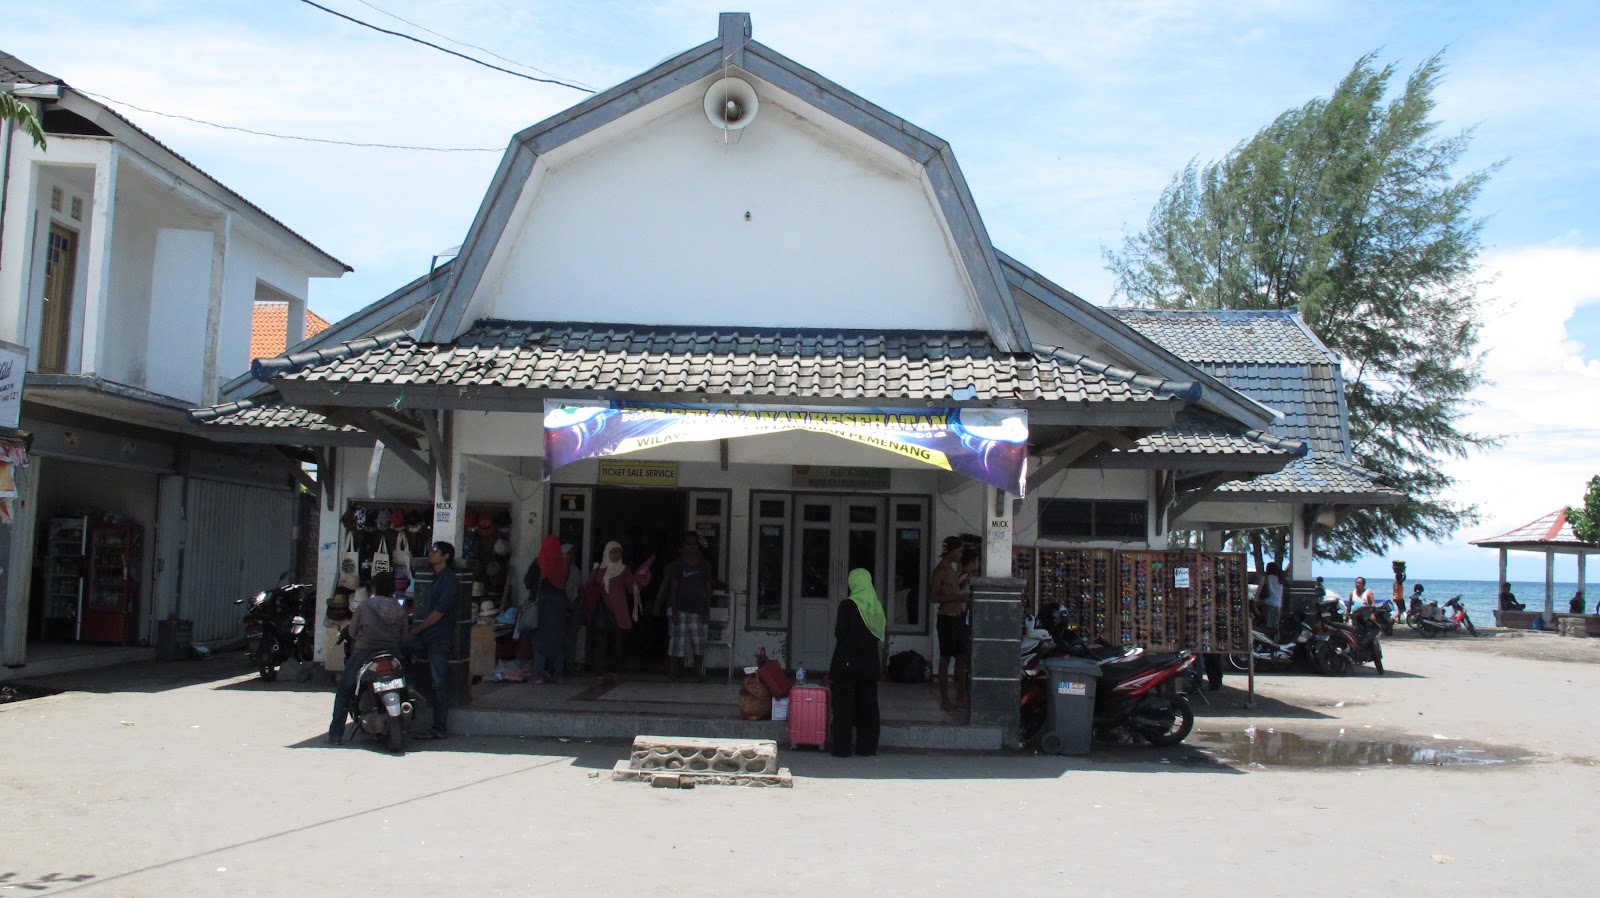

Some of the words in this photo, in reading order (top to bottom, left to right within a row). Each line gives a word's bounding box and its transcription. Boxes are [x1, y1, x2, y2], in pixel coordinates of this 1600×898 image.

[809, 413, 948, 430] KESEHATAN
[849, 433, 931, 460] PEMENANG
[602, 468, 625, 476] TICKET
[628, 469, 644, 477] SALE
[646, 469, 675, 478] SERVICE
[992, 520, 1009, 528] MUCK
